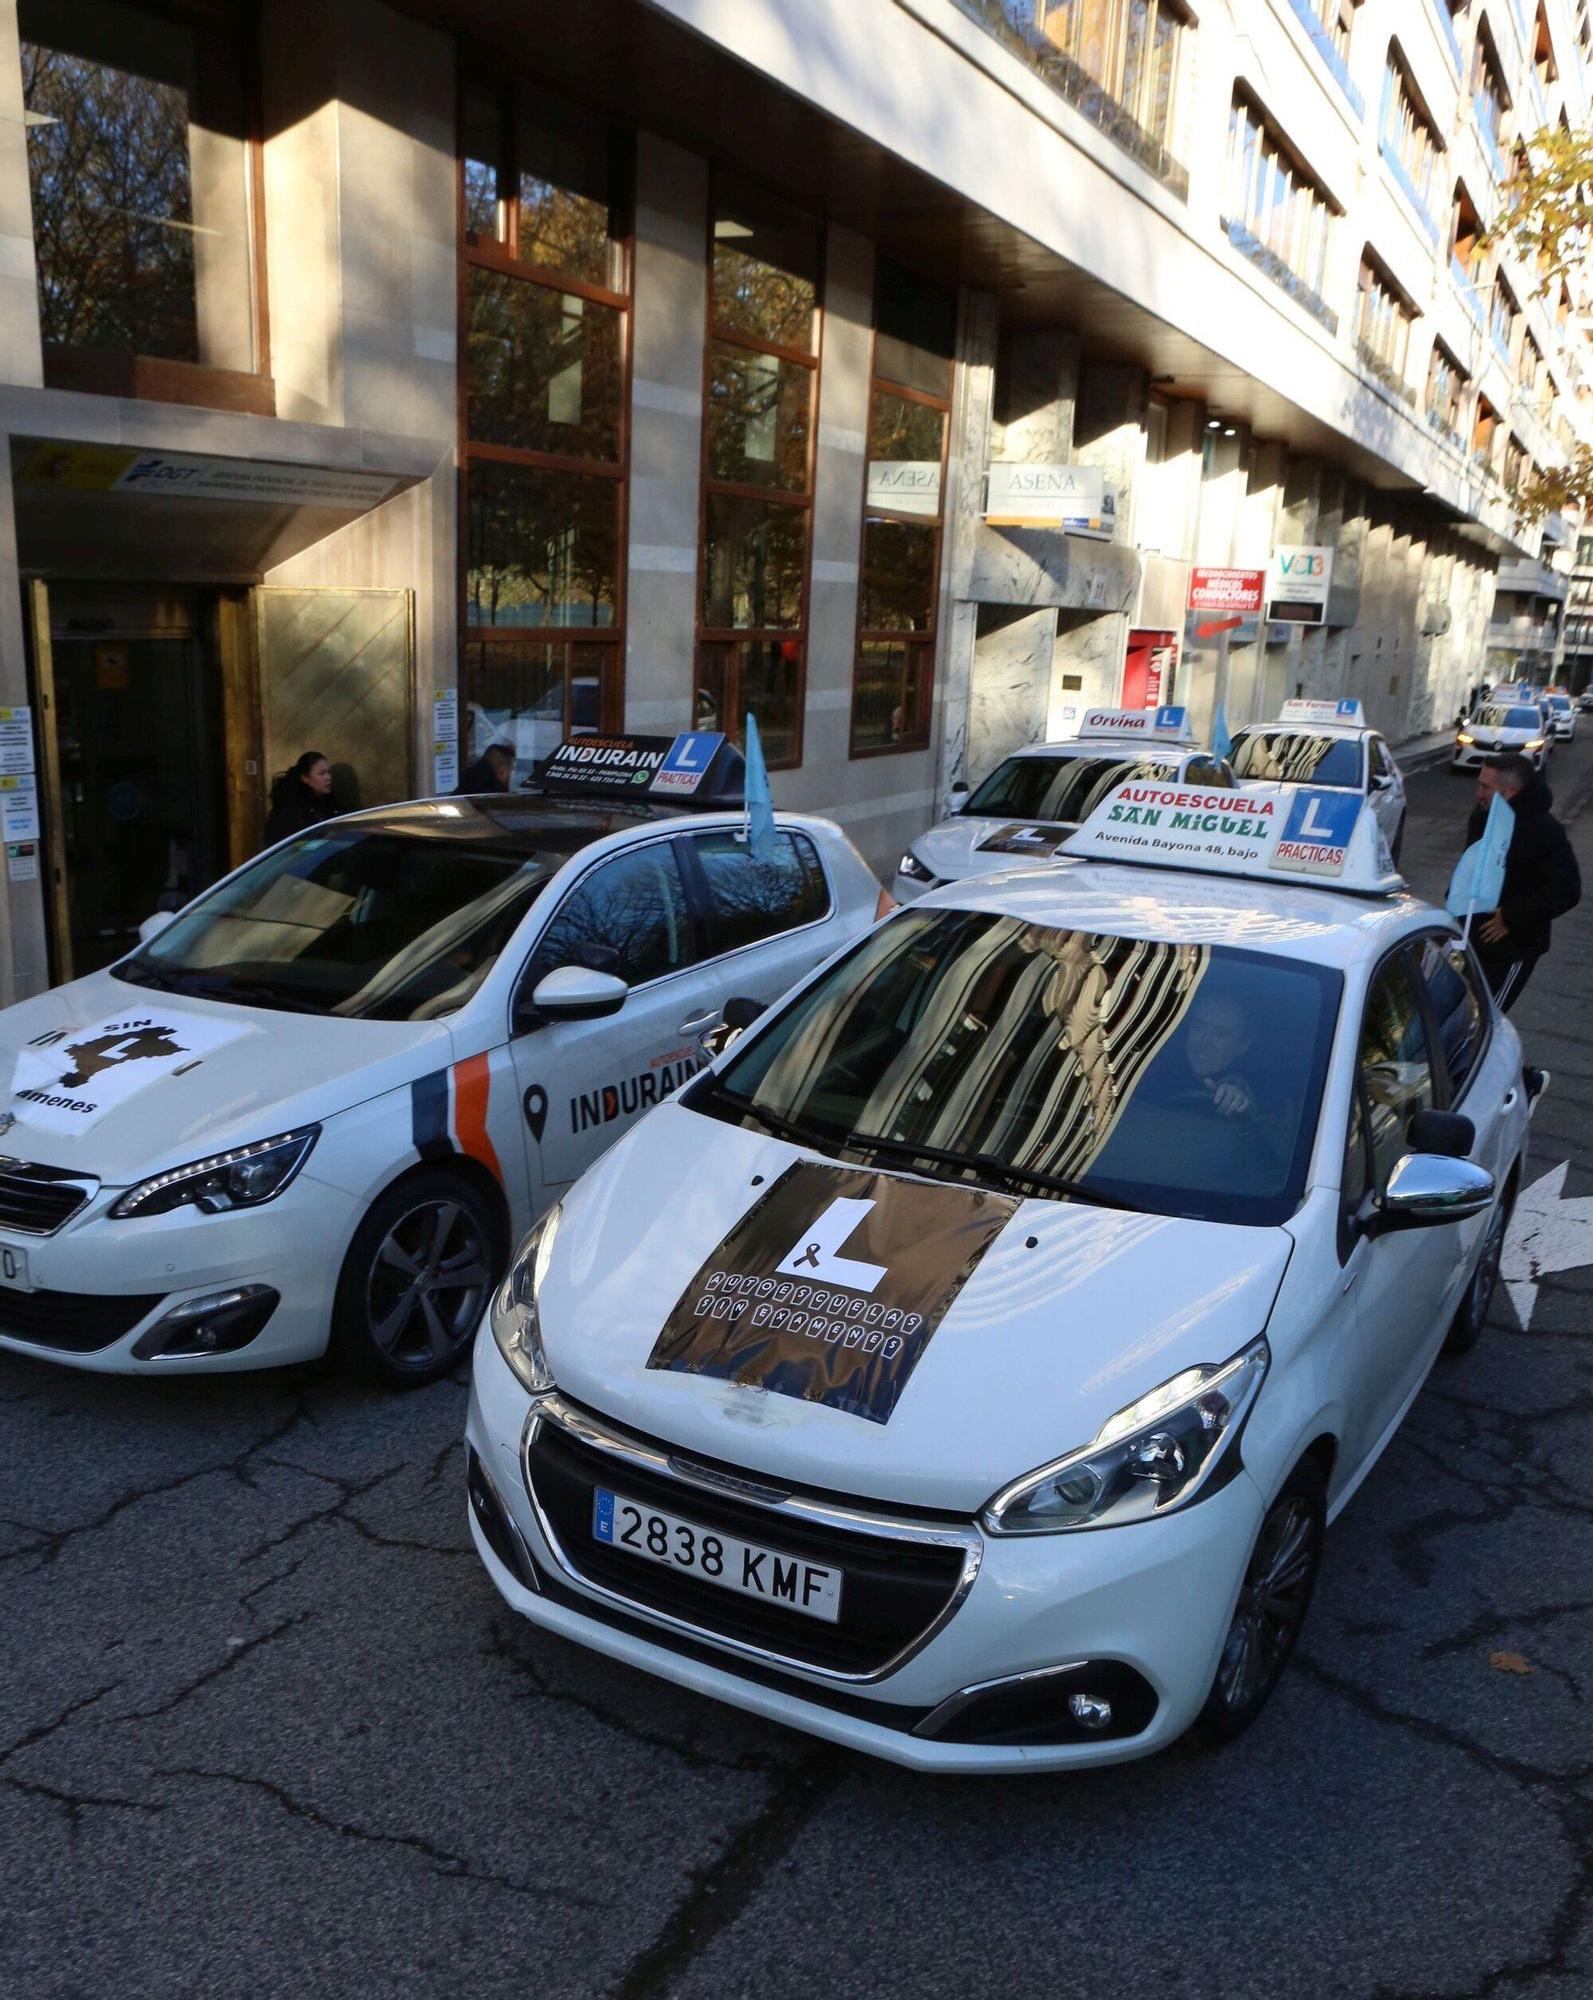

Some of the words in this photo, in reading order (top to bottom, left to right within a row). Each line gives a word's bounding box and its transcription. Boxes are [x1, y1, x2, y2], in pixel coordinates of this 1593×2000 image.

[156, 466, 199, 481] DGT
[1009, 472, 1077, 491] ASENA
[1192, 588, 1260, 601] CONDUCTORES
[1161, 709, 1175, 725] L
[1341, 701, 1353, 713] L
[1089, 713, 1146, 729] Orvina
[566, 737, 634, 749] AUTOESCUELA
[676, 738, 698, 767] L
[555, 745, 665, 769] INDURAIN
[657, 771, 698, 786] PRACTICAS
[1117, 787, 1275, 816] AUTOESCUELA
[1107, 804, 1163, 827] SAN
[1299, 798, 1334, 838] L
[1095, 831, 1149, 847] Avenida
[1151, 838, 1202, 853] Bayona
[1204, 844, 1225, 856] 48,
[1227, 848, 1259, 861] bajo
[1276, 842, 1344, 864] PRACTICAS
[103, 1018, 153, 1033] SIN
[775, 1197, 888, 1293] L
[706, 1272, 921, 1334] AUTOESCUELAS
[695, 1295, 748, 1321] SIN
[752, 1304, 903, 1358] EXAMENES
[600, 1521, 609, 1534] E
[620, 1506, 724, 1577] 2838
[742, 1548, 830, 1606] KMF
